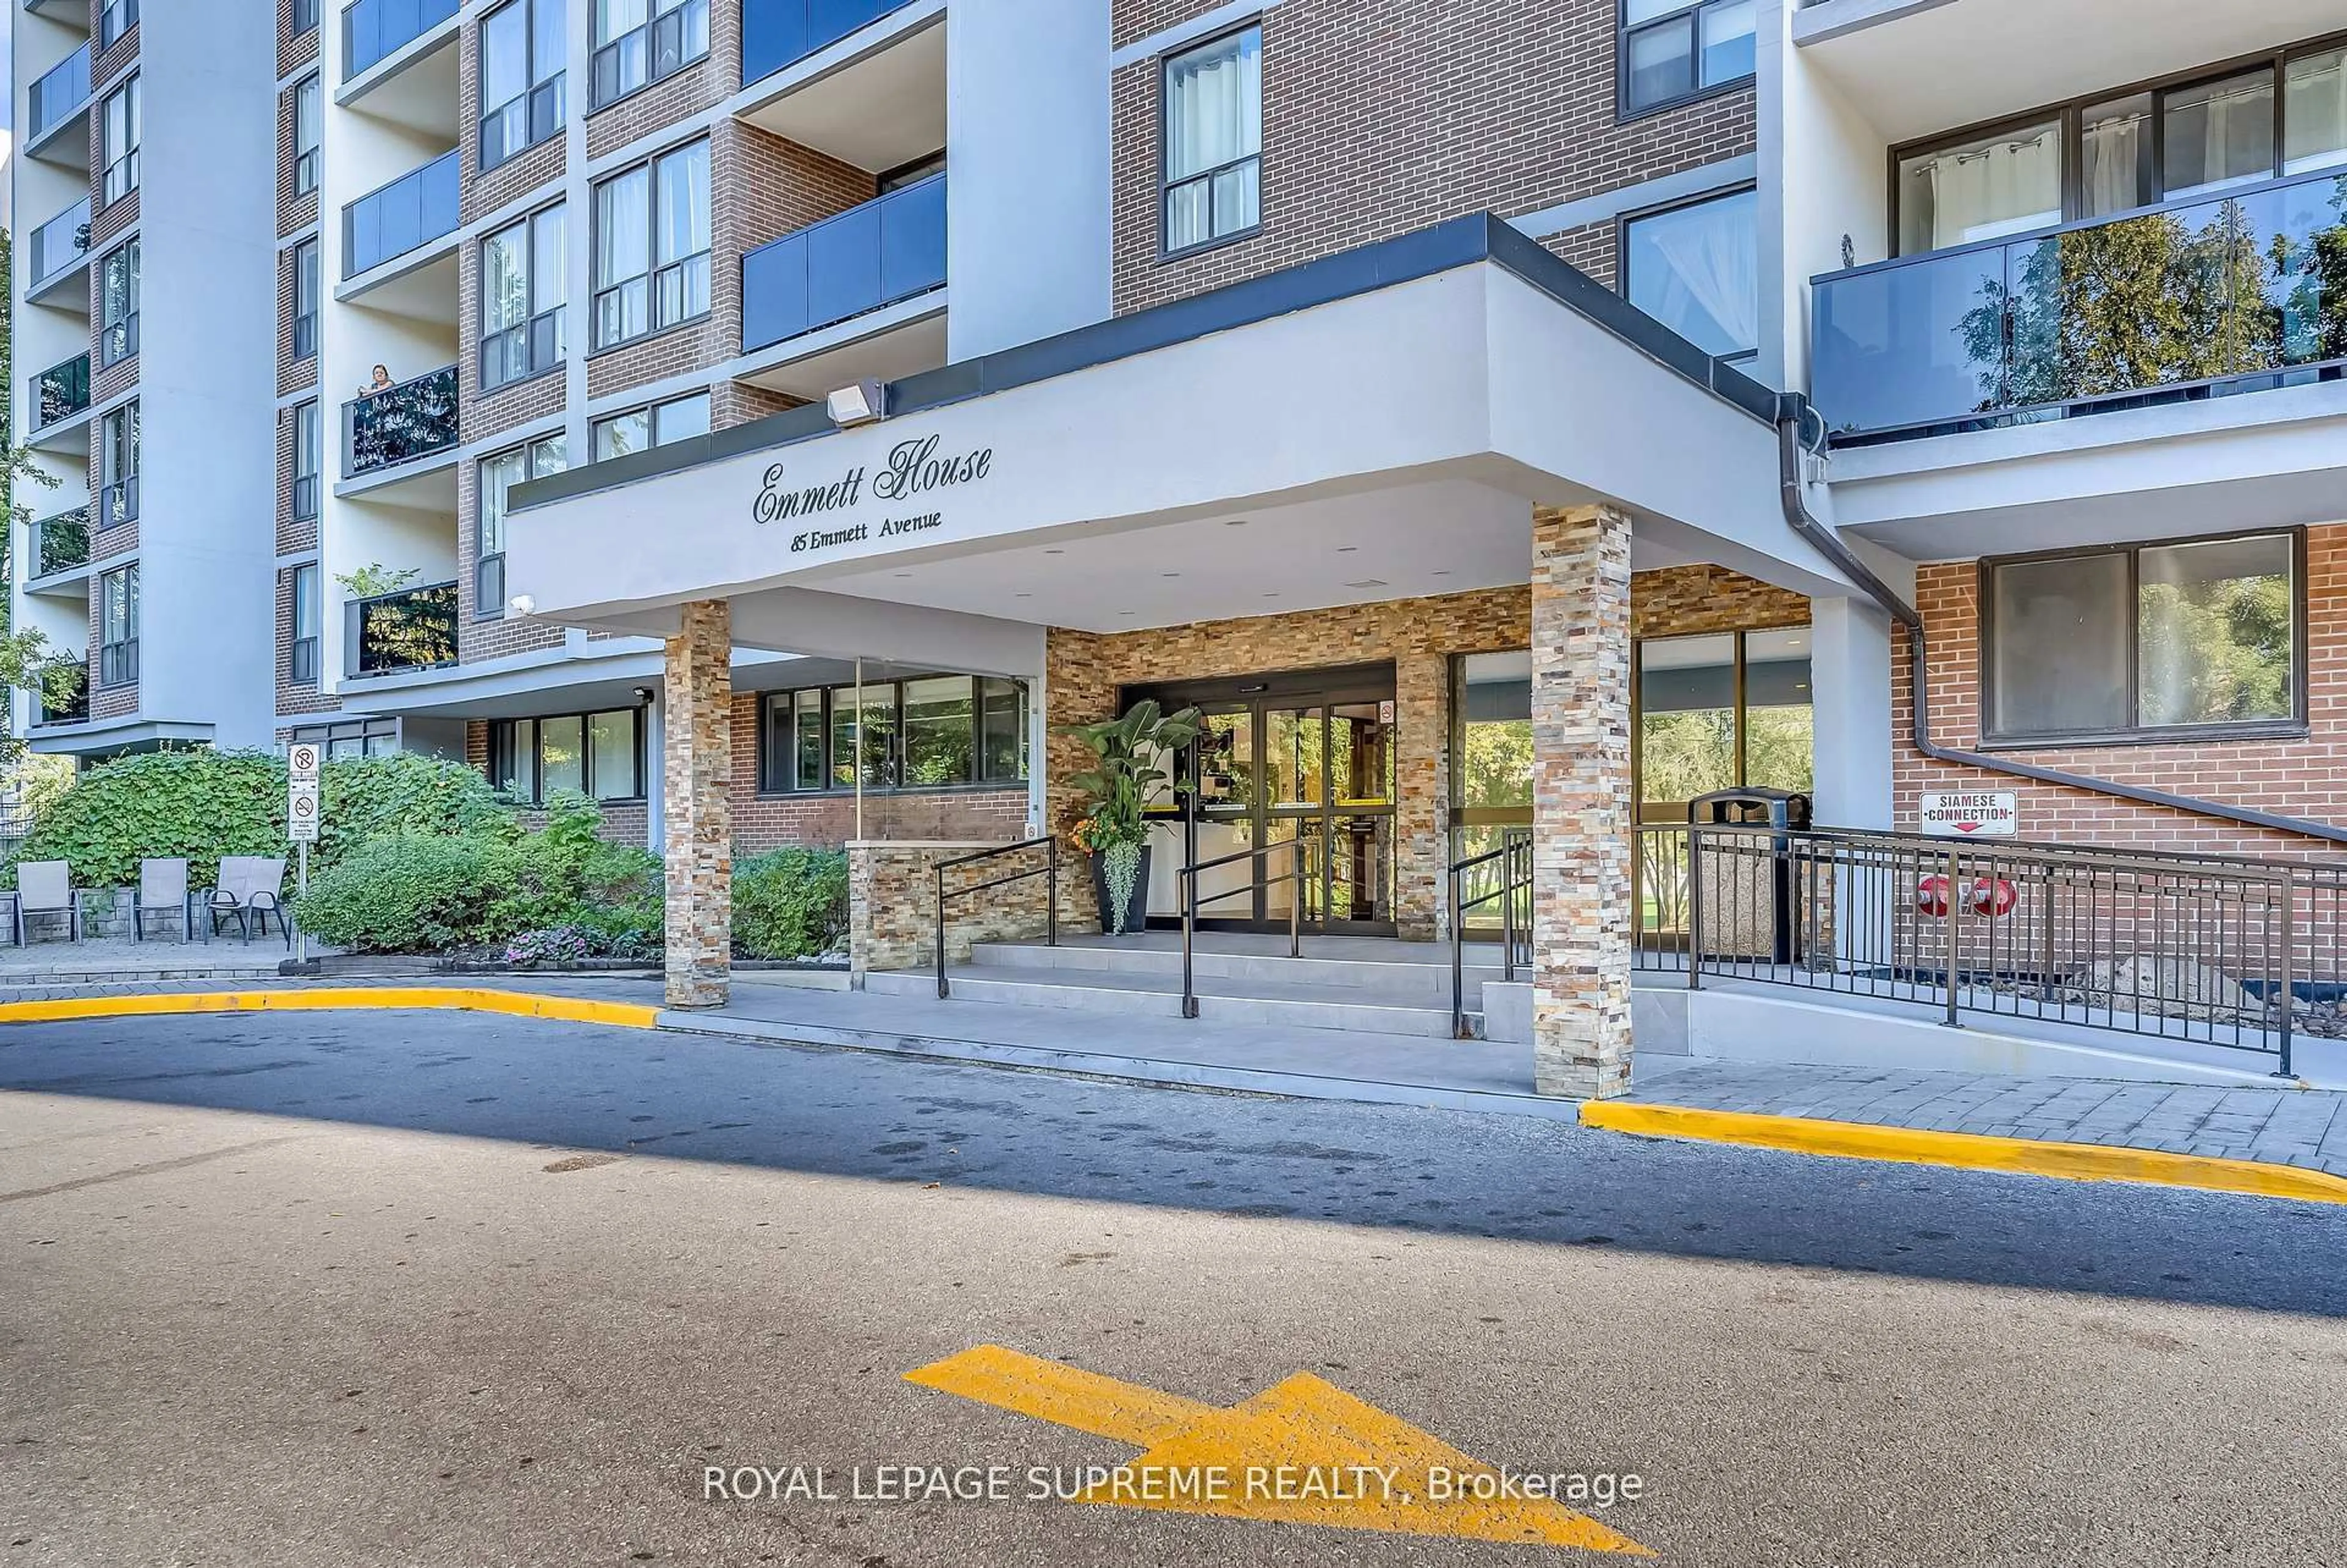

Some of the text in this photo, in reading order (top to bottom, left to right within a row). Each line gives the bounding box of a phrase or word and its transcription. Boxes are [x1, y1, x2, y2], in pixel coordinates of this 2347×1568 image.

[753, 434, 992, 524] Emmett House
[791, 511, 942, 552] 85 Emmett Avenue
[1940, 795, 1996, 807] SIAMESE
